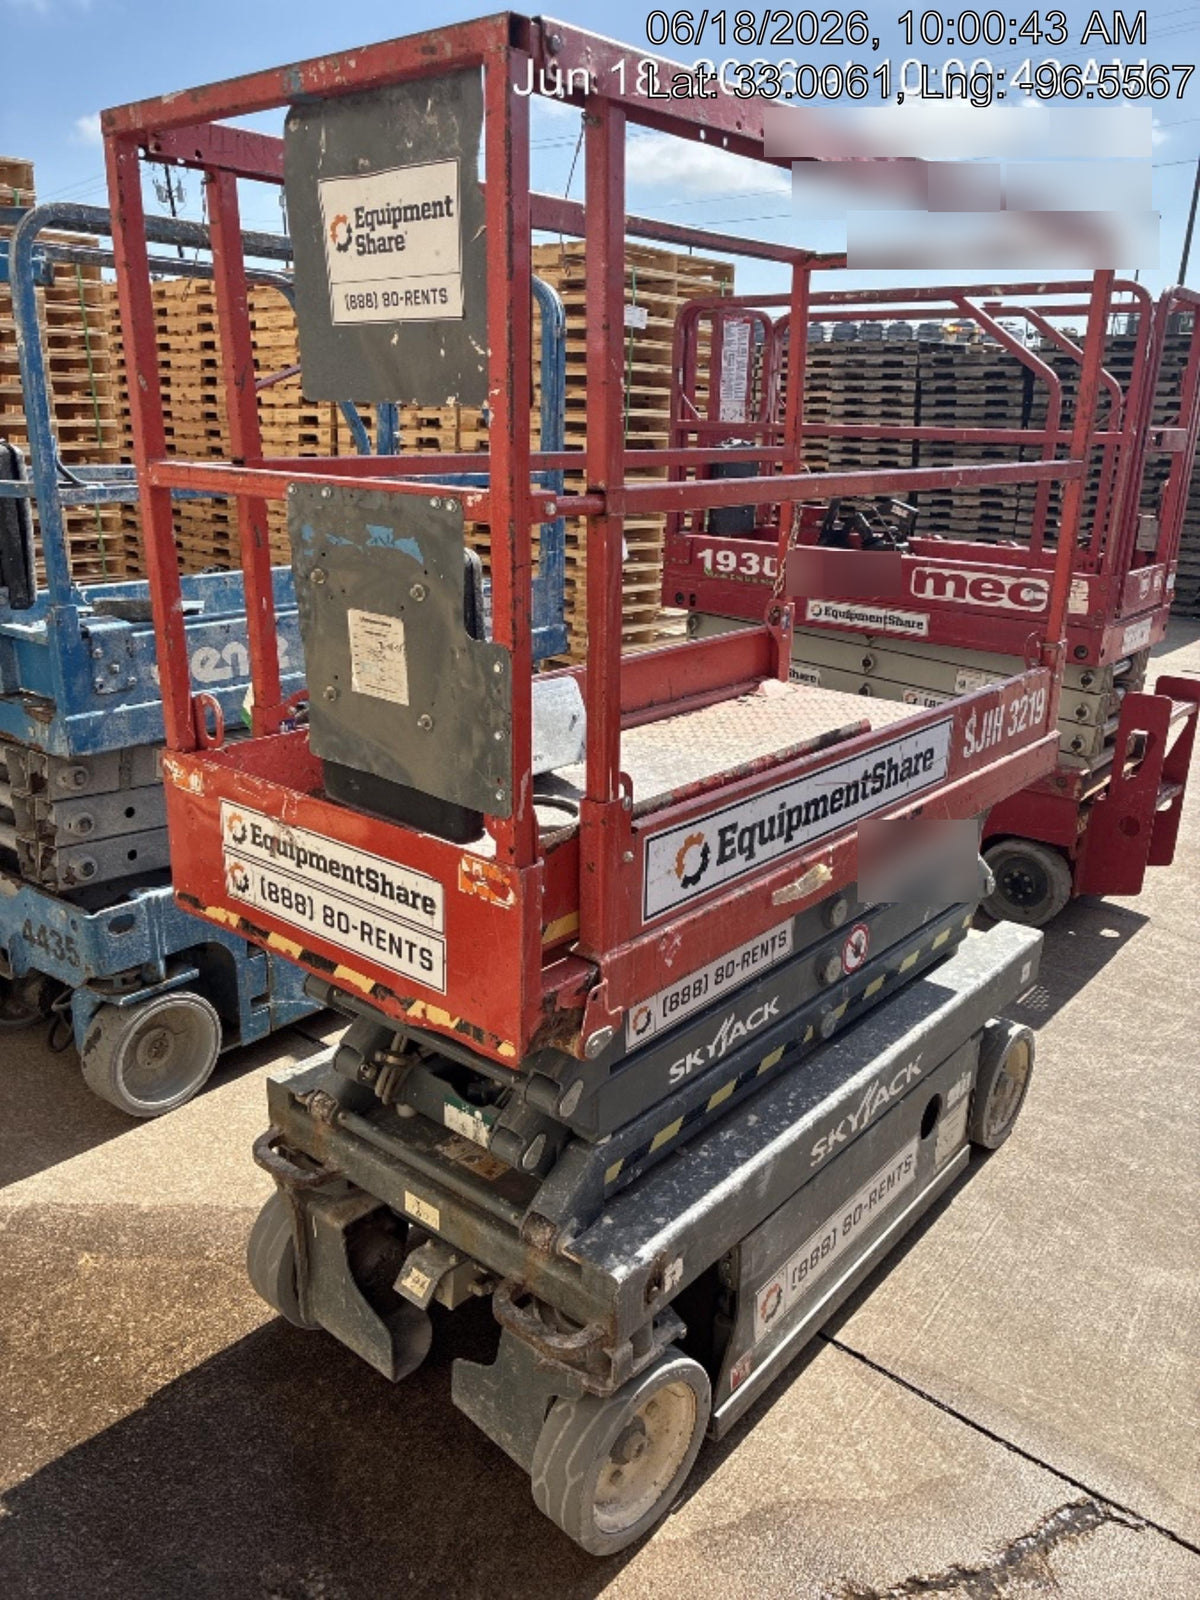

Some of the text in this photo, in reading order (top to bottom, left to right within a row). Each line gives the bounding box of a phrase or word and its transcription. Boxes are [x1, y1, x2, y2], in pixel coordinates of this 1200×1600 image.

[354, 194, 454, 231] Equipment
[356, 230, 405, 256] Share
[345, 287, 448, 311] (888) 80-RENTS
[914, 570, 1048, 607] mec
[823, 606, 924, 630] EquipmentShare
[1007, 688, 1046, 737] 3219
[715, 746, 935, 865] EquipmentShare
[250, 823, 436, 917] EquipmentShare
[22, 919, 81, 969] 4435
[259, 874, 434, 972] (888) 80-RENTS
[714, 929, 787, 986] 80-RENTS
[669, 995, 780, 1085] SKYJACK
[811, 1053, 922, 1167] SKYJACK
[841, 1152, 913, 1238] 80-RENTS
